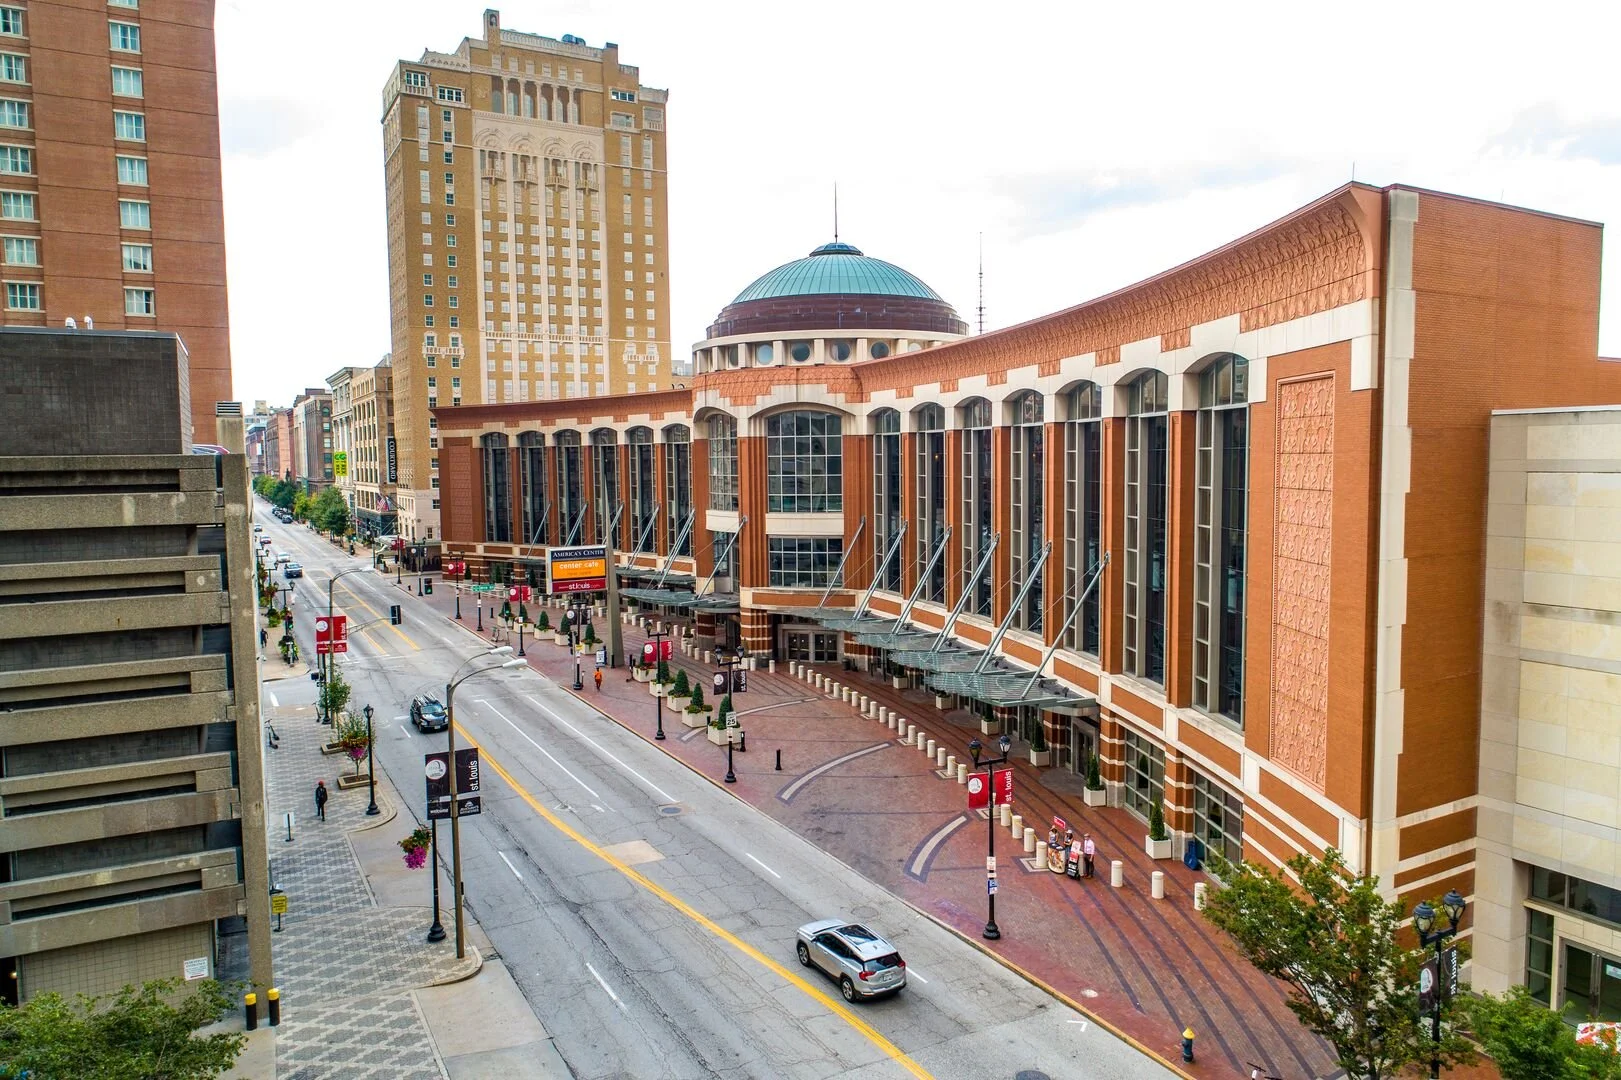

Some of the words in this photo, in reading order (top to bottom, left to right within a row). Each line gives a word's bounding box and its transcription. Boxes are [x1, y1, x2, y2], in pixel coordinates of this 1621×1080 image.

[553, 550, 582, 558] AMERICA'S
[584, 560, 599, 568] cafe
[469, 760, 479, 780] louis
[471, 780, 479, 791] st.
